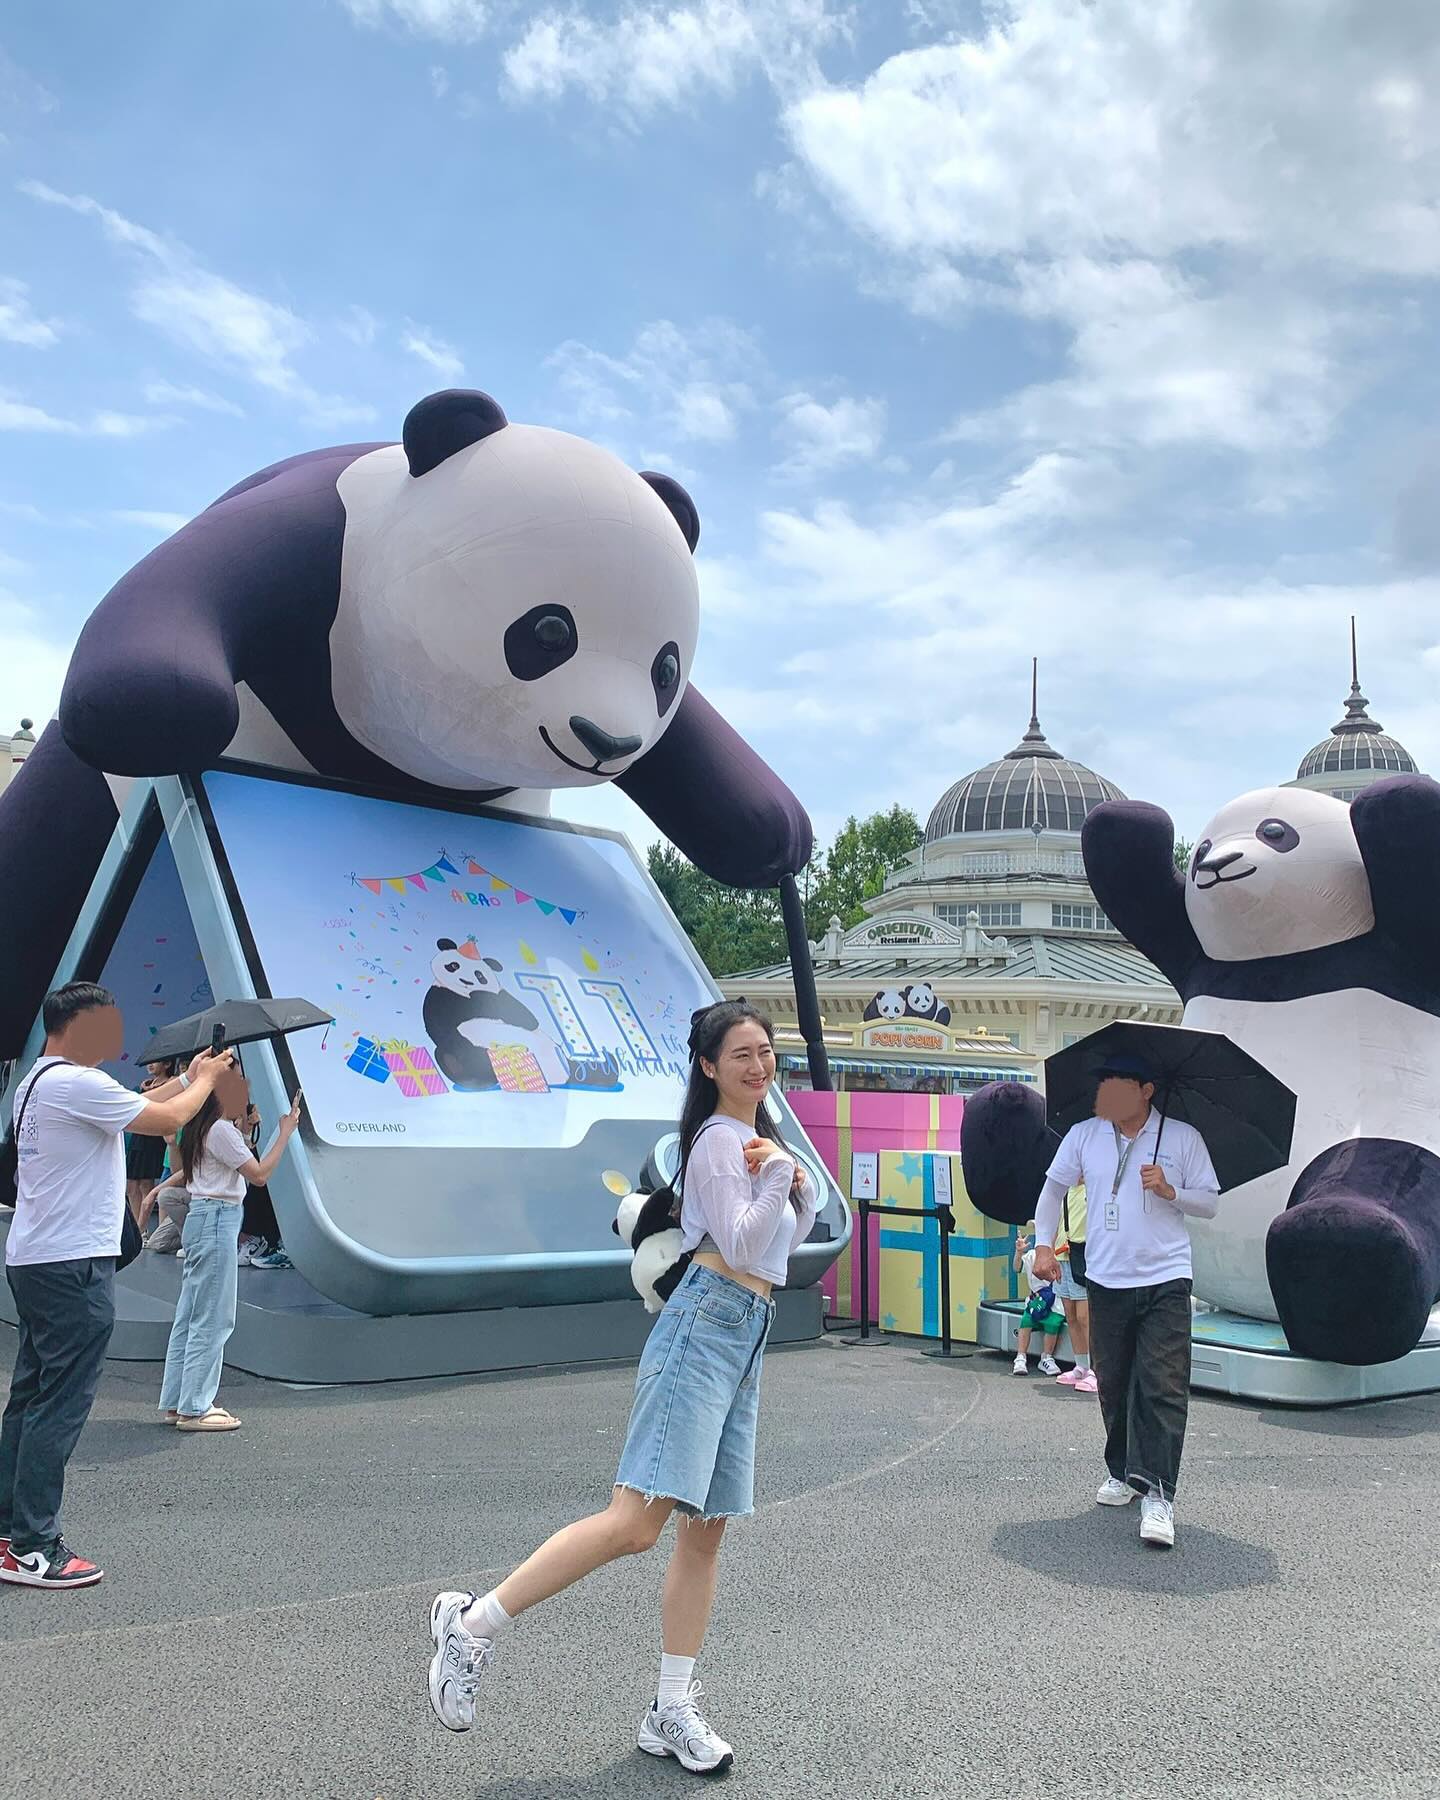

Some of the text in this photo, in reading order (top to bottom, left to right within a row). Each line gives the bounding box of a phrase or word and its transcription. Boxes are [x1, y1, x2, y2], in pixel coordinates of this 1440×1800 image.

[451, 888, 501, 907] AIBAO
[867, 922, 933, 939] ORIENTAL
[880, 936, 920, 944] Restaurant
[903, 1034, 943, 1049] CORN
